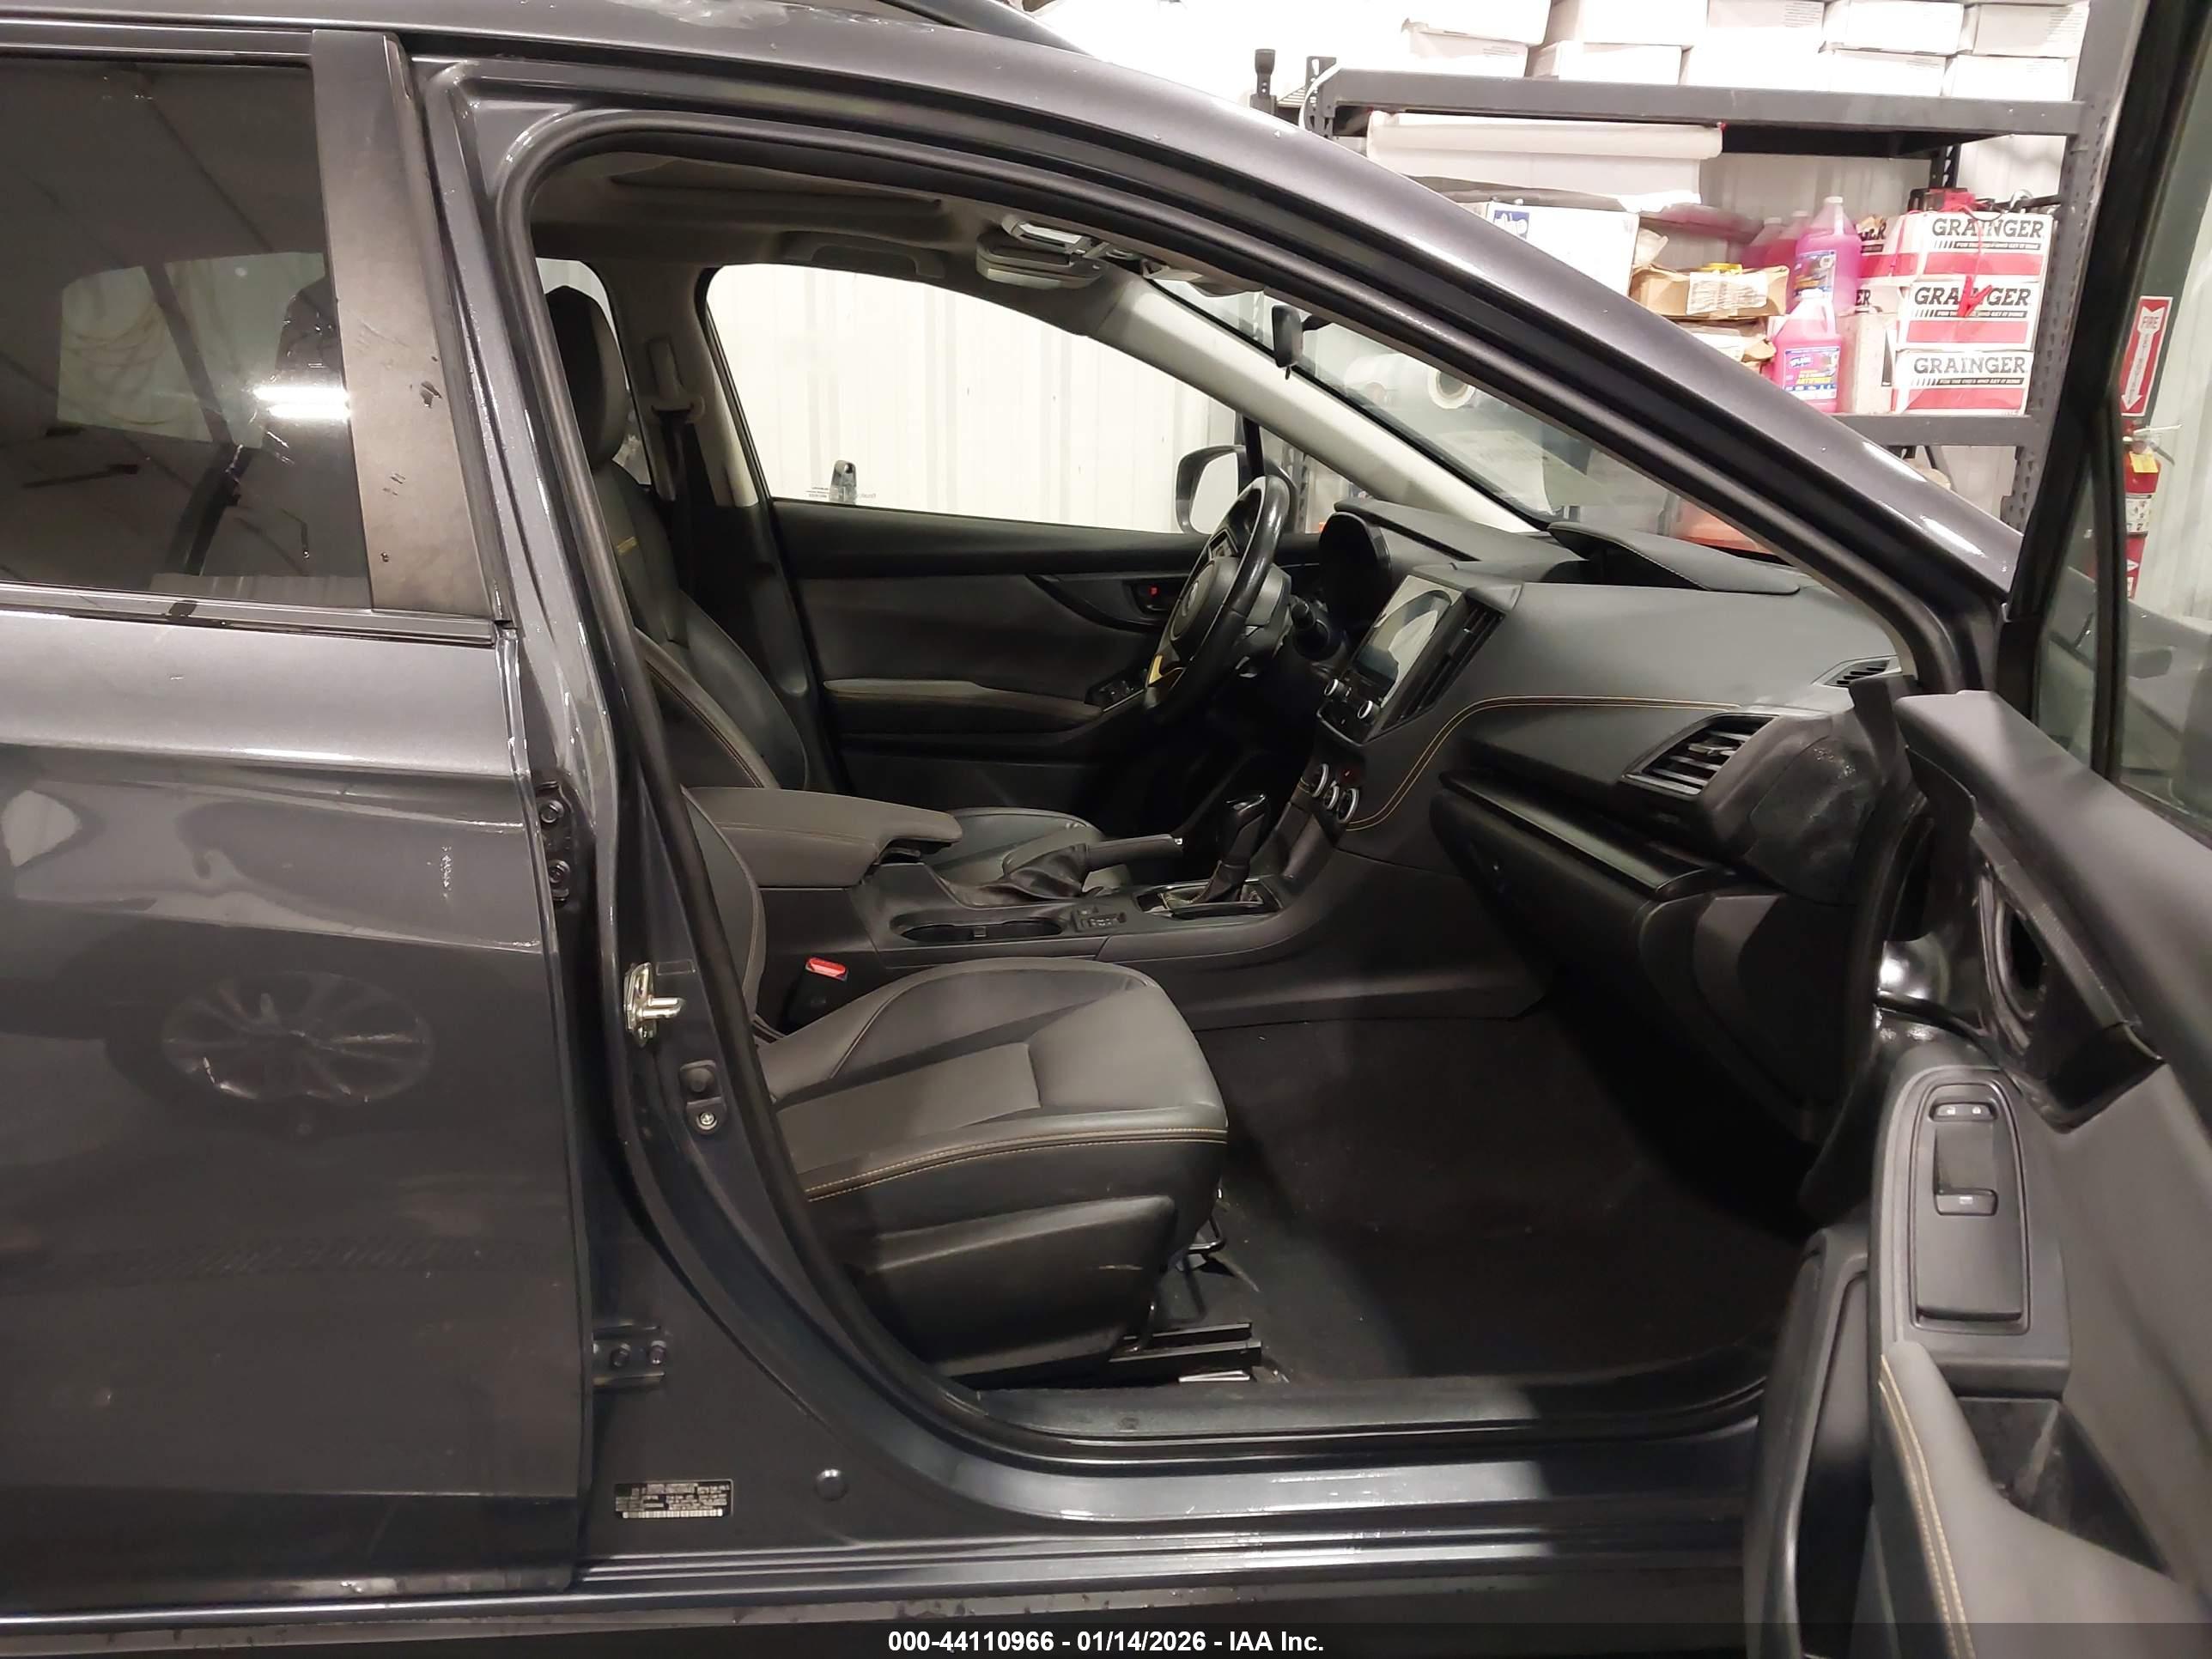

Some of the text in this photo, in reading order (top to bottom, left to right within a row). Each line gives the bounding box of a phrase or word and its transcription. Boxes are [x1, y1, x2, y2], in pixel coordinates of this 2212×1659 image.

[1932, 218, 2044, 238] GRAINGER
[1914, 287, 2032, 307] GRAGER
[1913, 356, 2026, 374] GRAINGER
